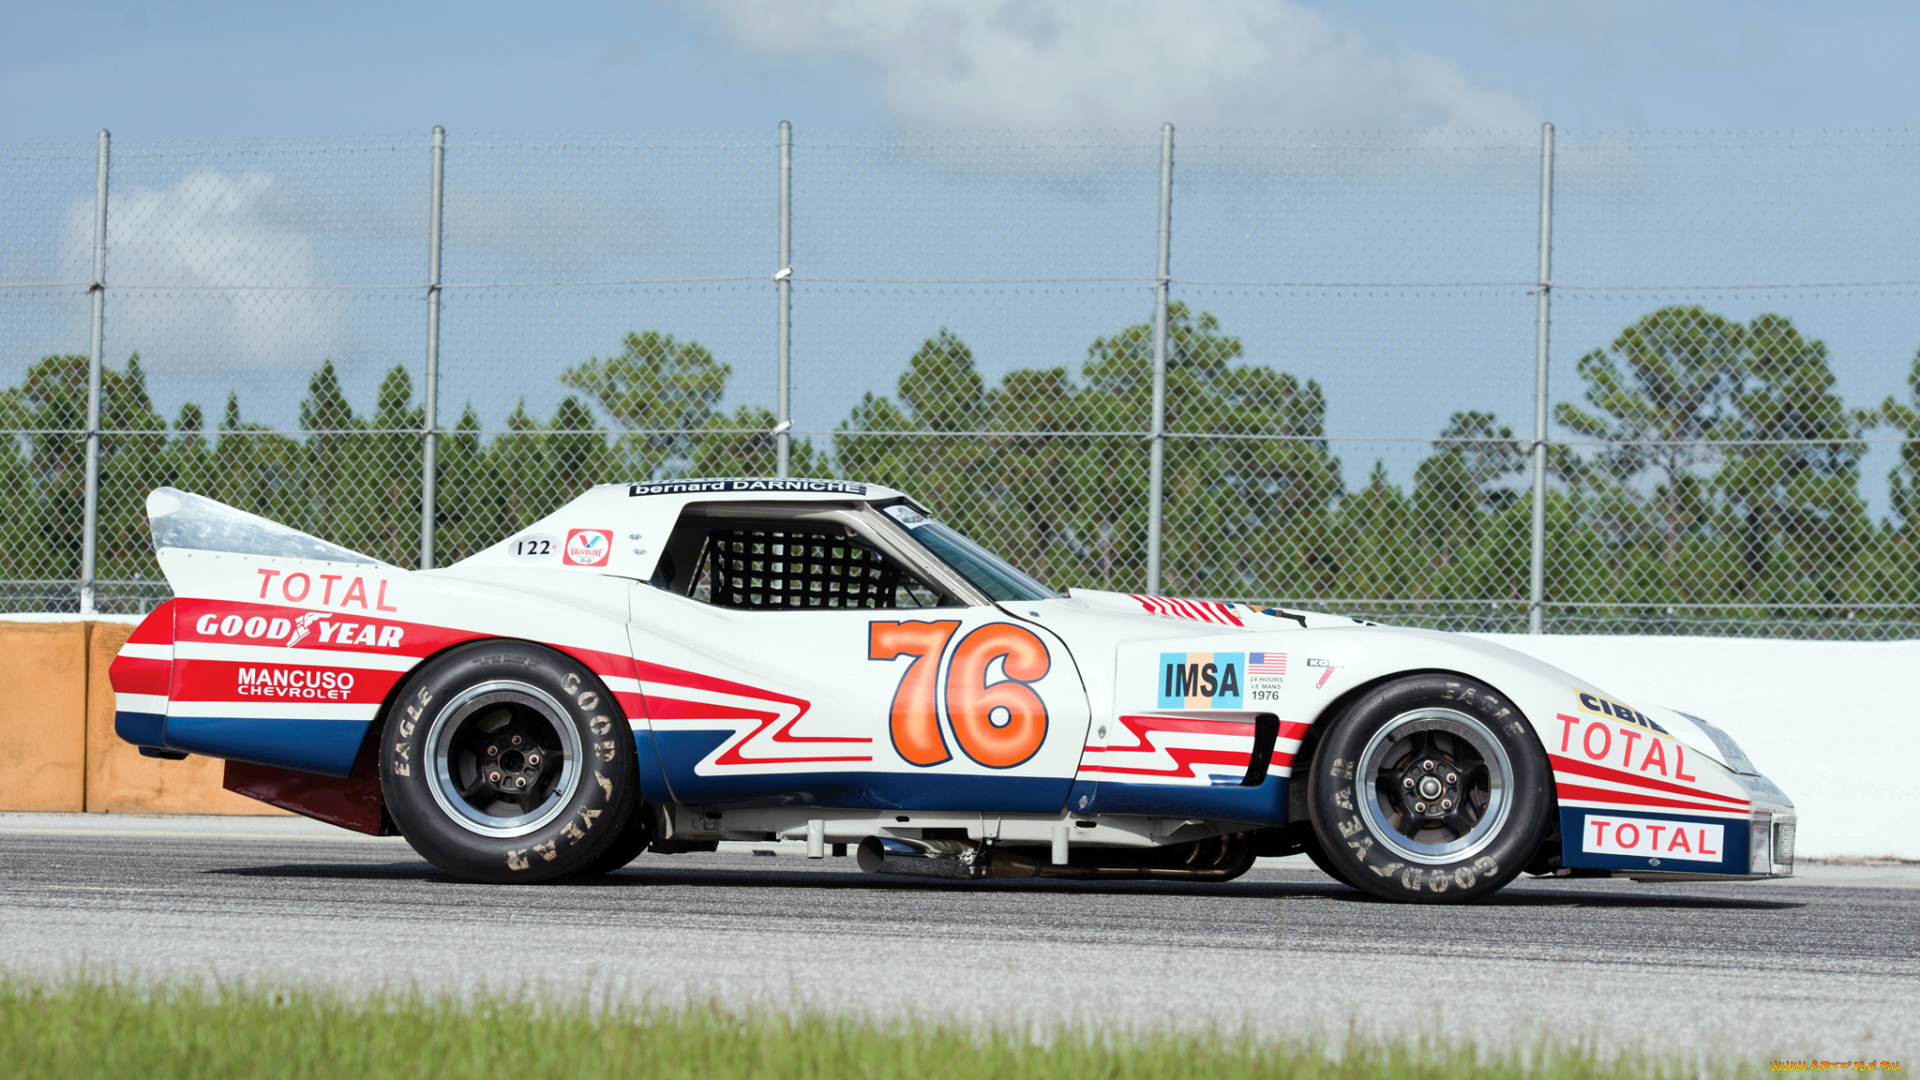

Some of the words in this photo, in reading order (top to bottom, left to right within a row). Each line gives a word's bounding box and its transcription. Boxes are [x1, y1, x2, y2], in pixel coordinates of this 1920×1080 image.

[635, 481, 725, 495] bernard
[732, 480, 861, 493] DARNICHE
[517, 540, 550, 556] 122
[570, 546, 604, 558] VALVOLINE
[257, 568, 398, 613] TOTAL
[237, 667, 354, 690] MANCUSO
[237, 684, 351, 700] CHEVROLET
[868, 620, 1051, 770] 76
[1164, 662, 1240, 698] IMSA
[1251, 690, 1279, 701] 1976
[1441, 682, 1525, 737] EALE
[395, 685, 433, 778] EAGLE
[1556, 712, 1697, 783] TOTAL
[1590, 820, 1717, 855] TOTAL
